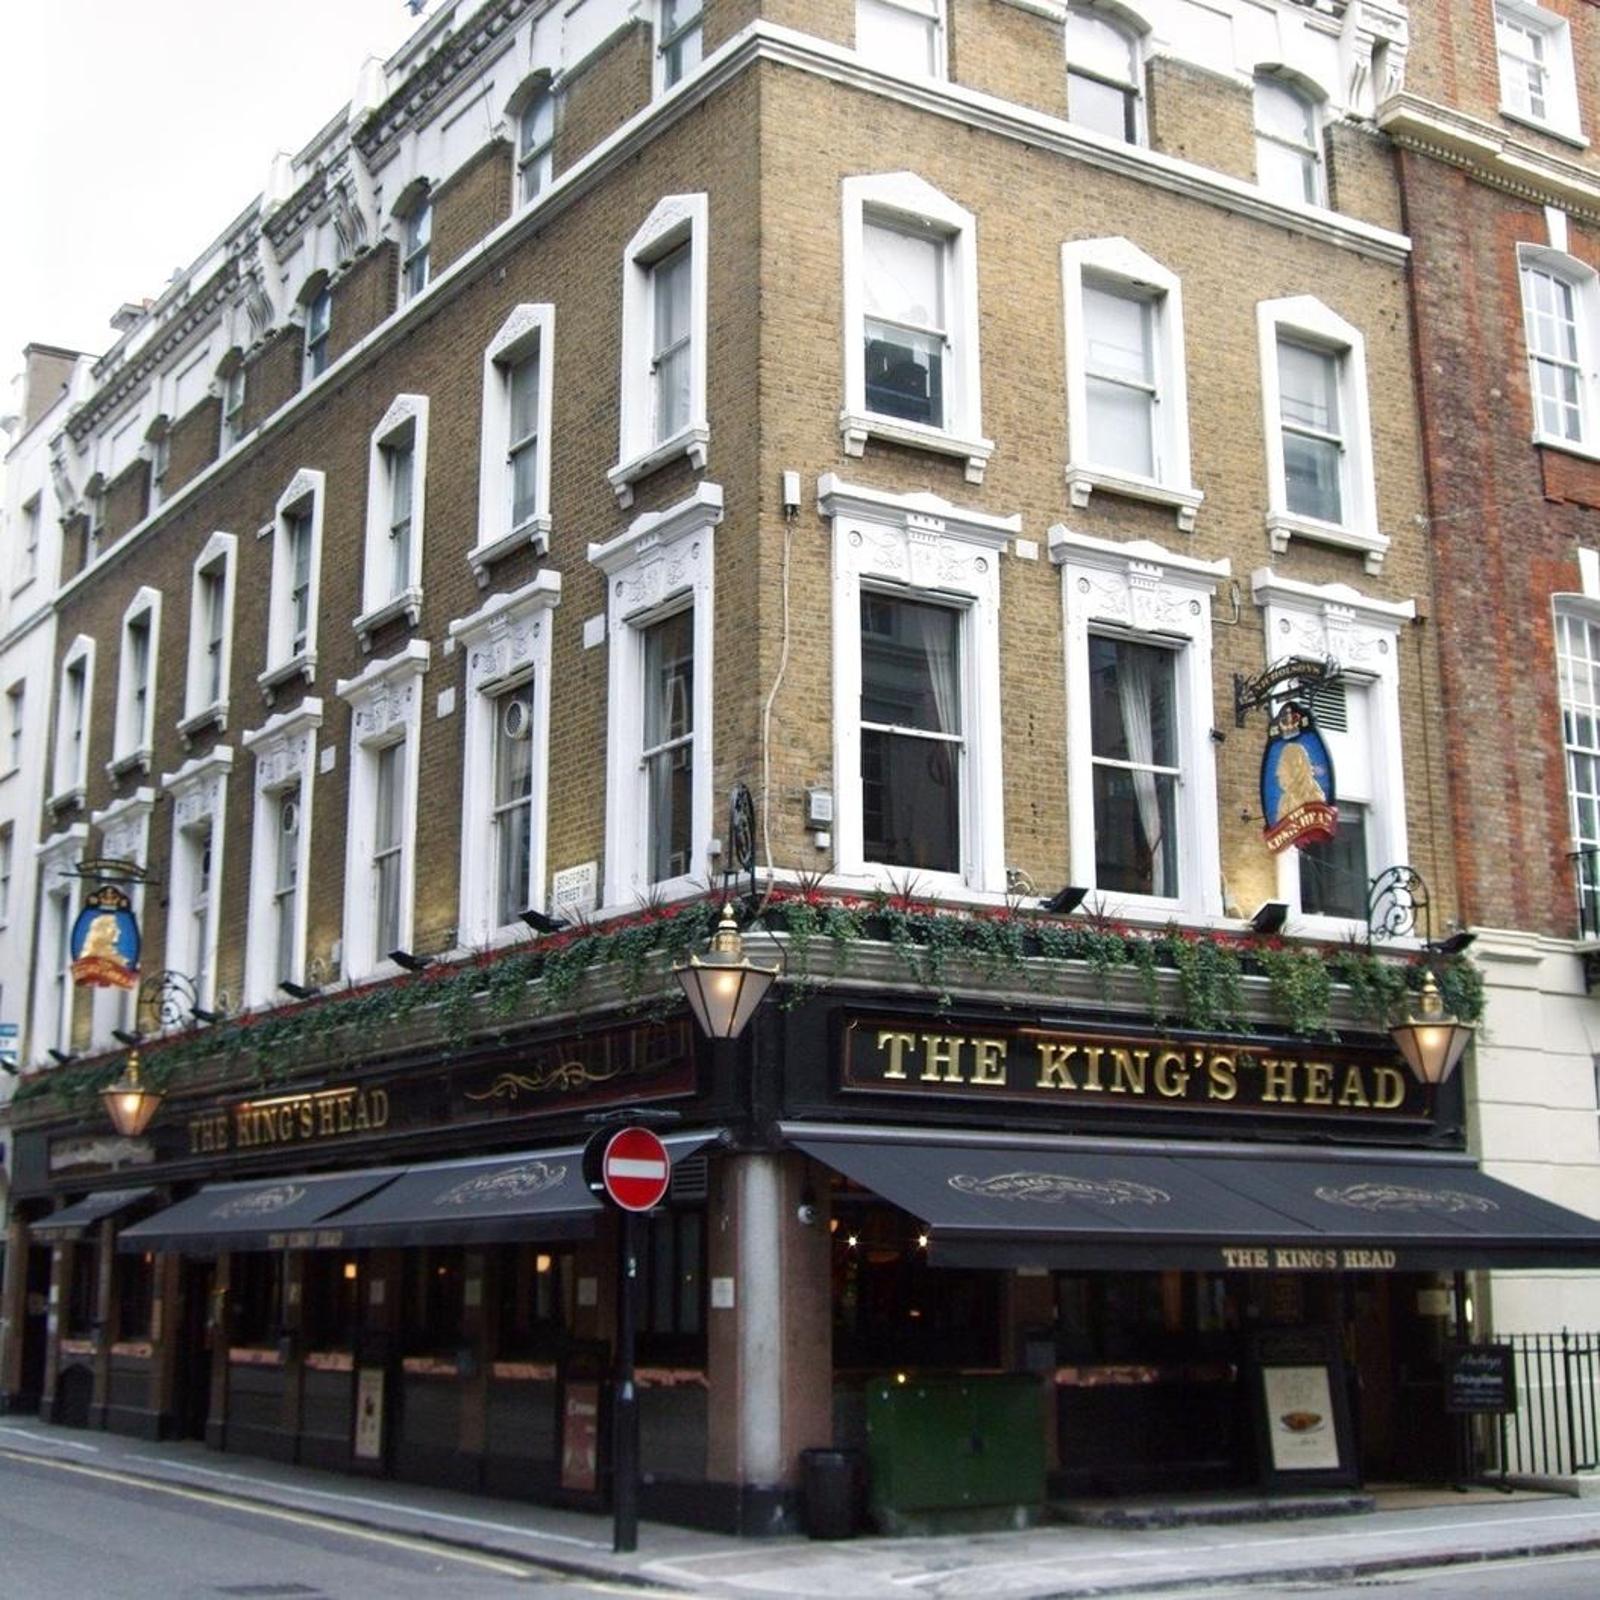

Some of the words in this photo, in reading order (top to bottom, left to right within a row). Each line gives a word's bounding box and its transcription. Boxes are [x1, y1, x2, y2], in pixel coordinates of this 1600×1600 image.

[1289, 807, 1305, 821] THE
[1299, 811, 1333, 828] HEAD
[557, 867, 590, 888] STAFFORD
[557, 886, 580, 905] STREET
[877, 1031, 1008, 1086] THE
[1036, 1043, 1240, 1101] KING'S
[1261, 1058, 1407, 1110] HEAD
[189, 1115, 228, 1153] THE
[236, 1102, 314, 1147] KING'S
[318, 1089, 389, 1134] HEAD
[1222, 1248, 1269, 1268] THE
[1343, 1250, 1397, 1269] HEAD
